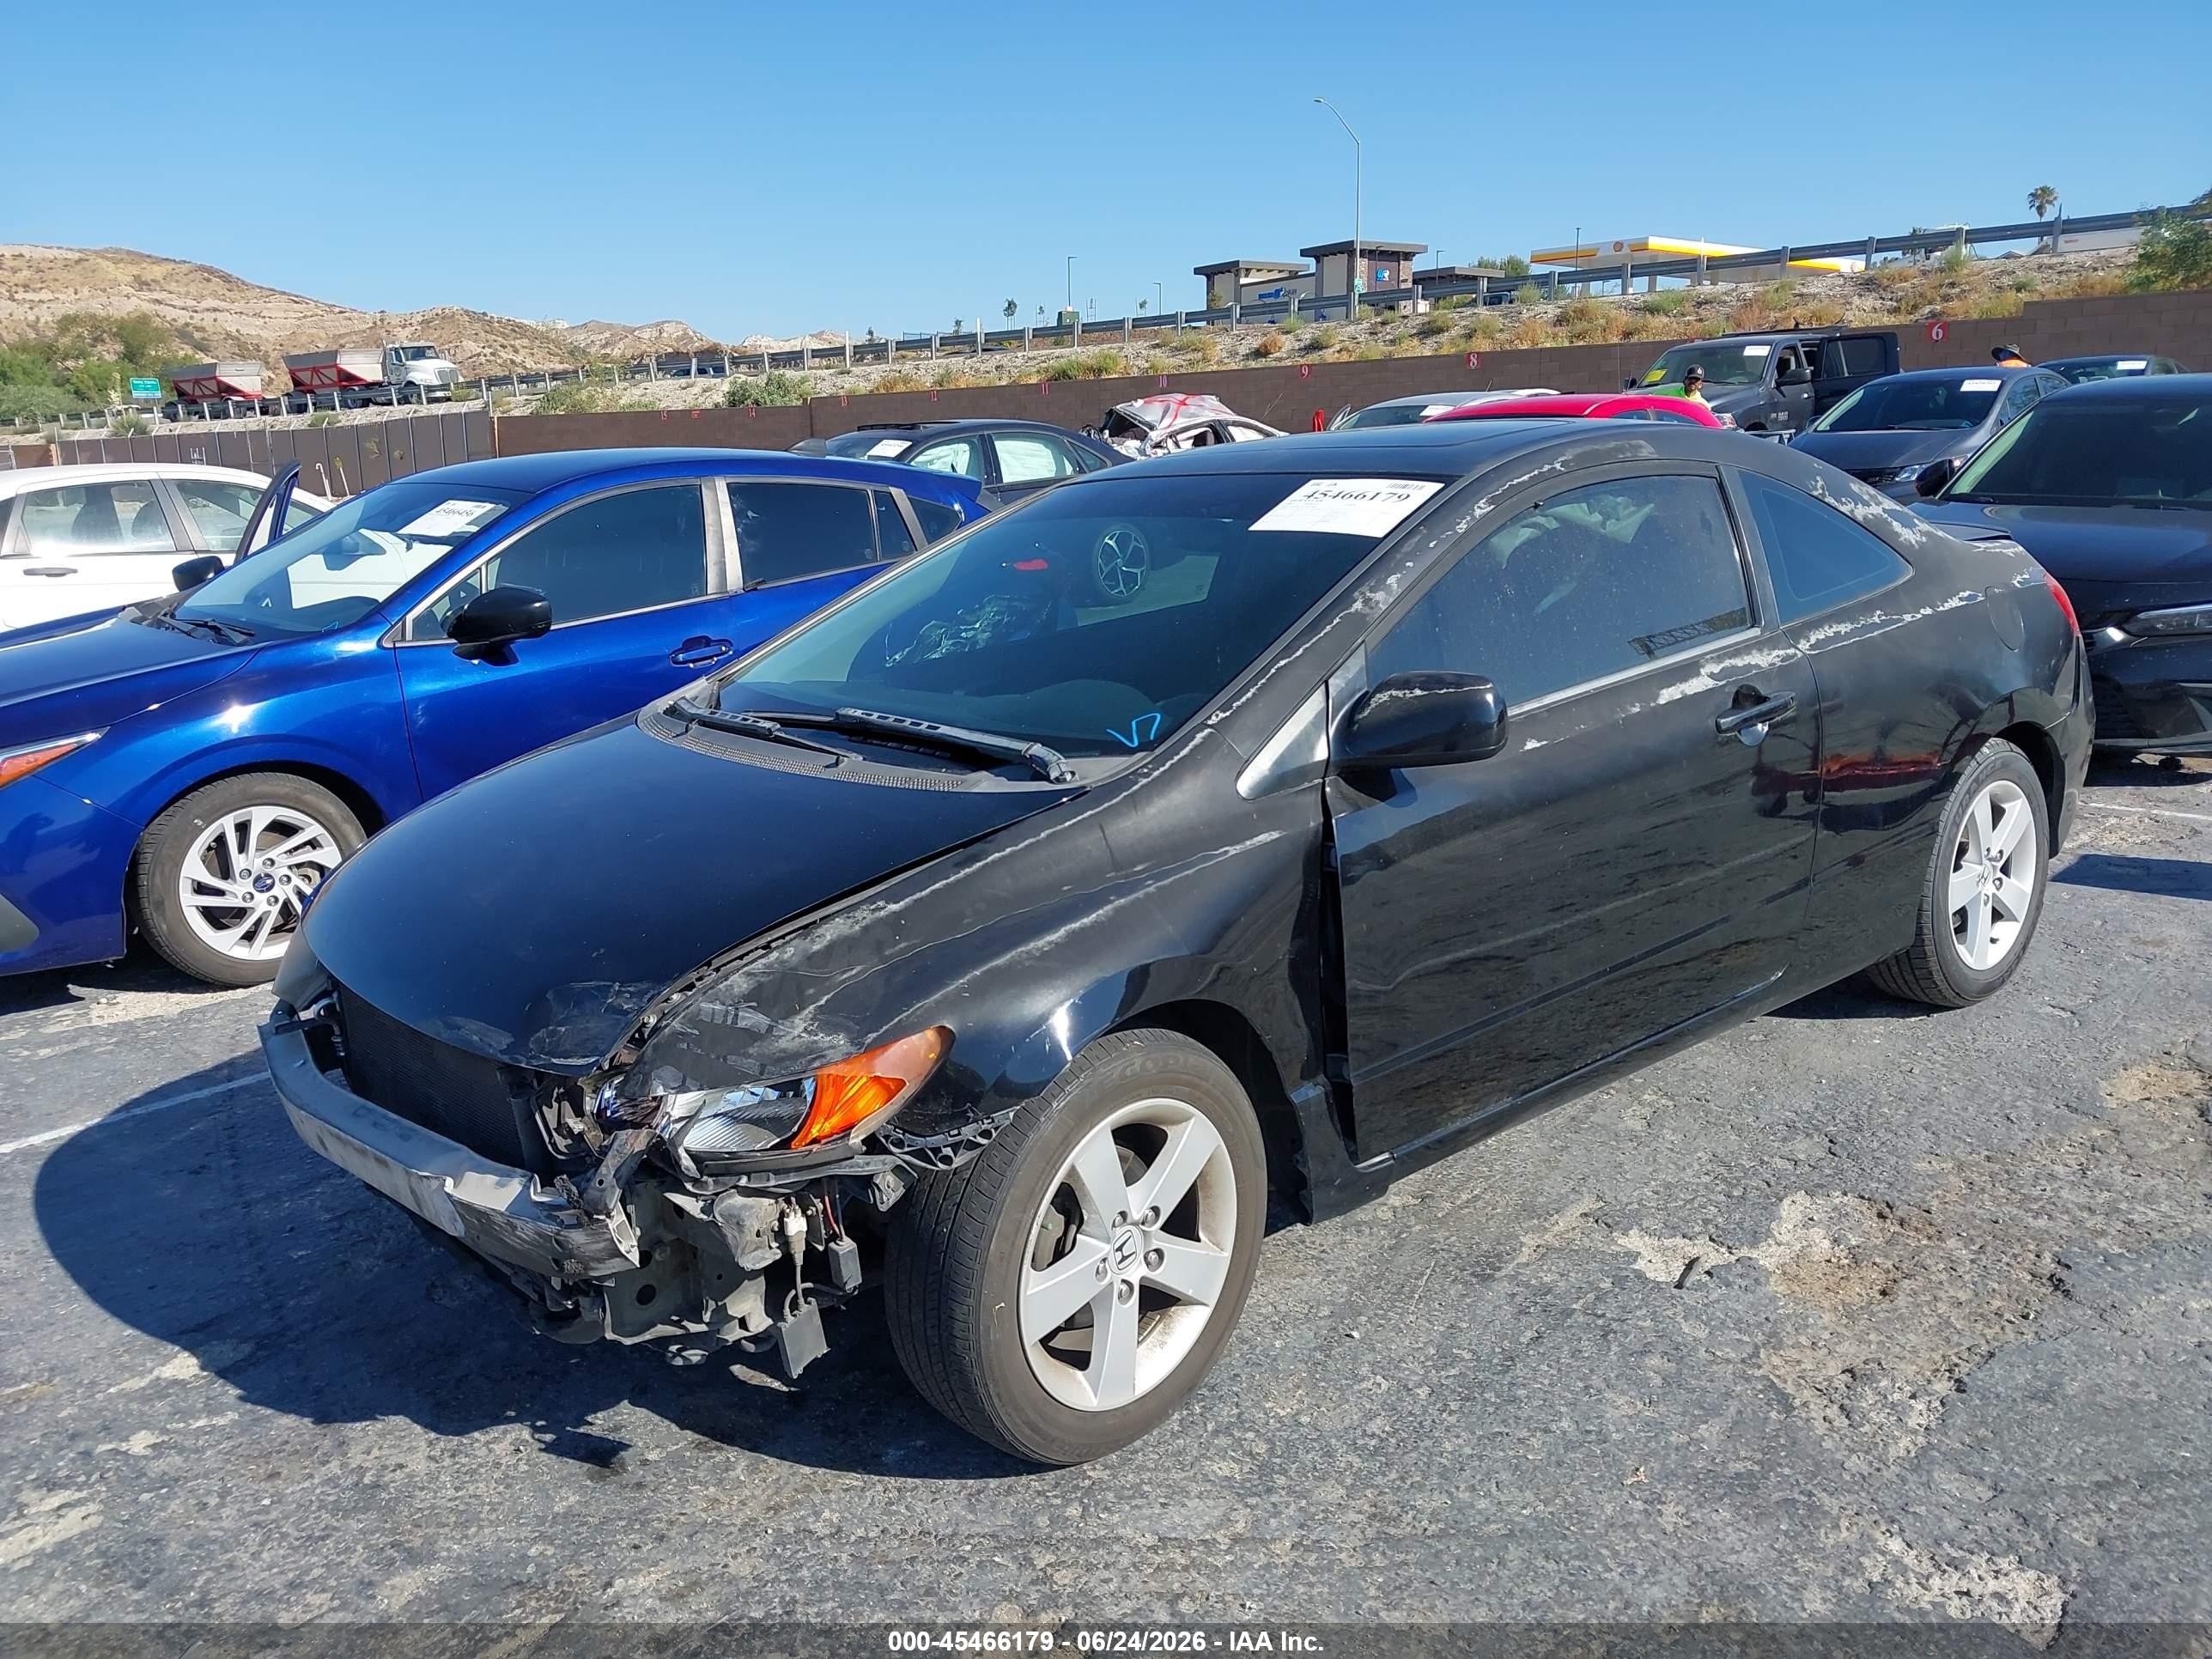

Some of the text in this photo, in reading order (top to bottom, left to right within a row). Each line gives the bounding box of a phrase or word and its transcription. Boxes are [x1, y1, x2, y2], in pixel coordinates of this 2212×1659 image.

[1932, 322, 1943, 340] 6
[1469, 353, 1478, 368] 8
[1302, 365, 1309, 379] 9
[1158, 374, 1168, 387] 10
[660, 410, 667, 420] 15
[749, 408, 756, 417] 14
[1302, 489, 1411, 503] 45466179
